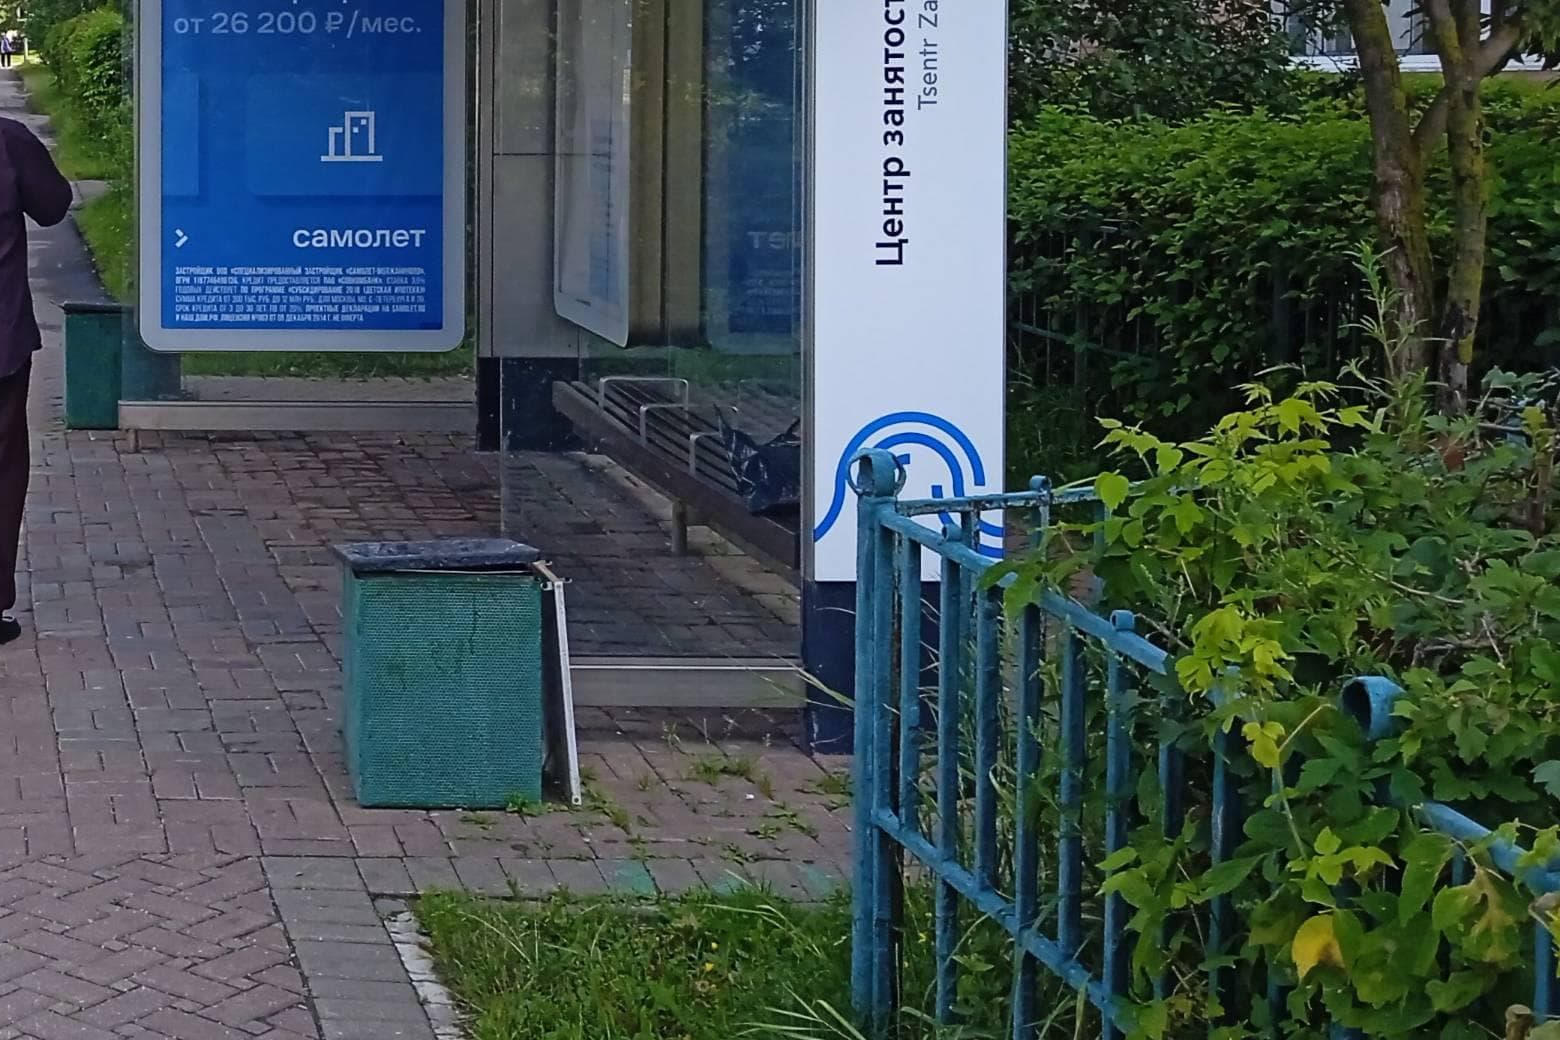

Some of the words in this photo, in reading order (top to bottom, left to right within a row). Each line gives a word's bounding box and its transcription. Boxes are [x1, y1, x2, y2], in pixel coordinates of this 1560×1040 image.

[174, 16, 204, 34] от
[212, 12, 248, 34] 26
[257, 12, 316, 34] 200
[918, 38, 939, 111] Tsentr
[876, 156, 911, 266] Центр
[293, 228, 426, 248] самолет
